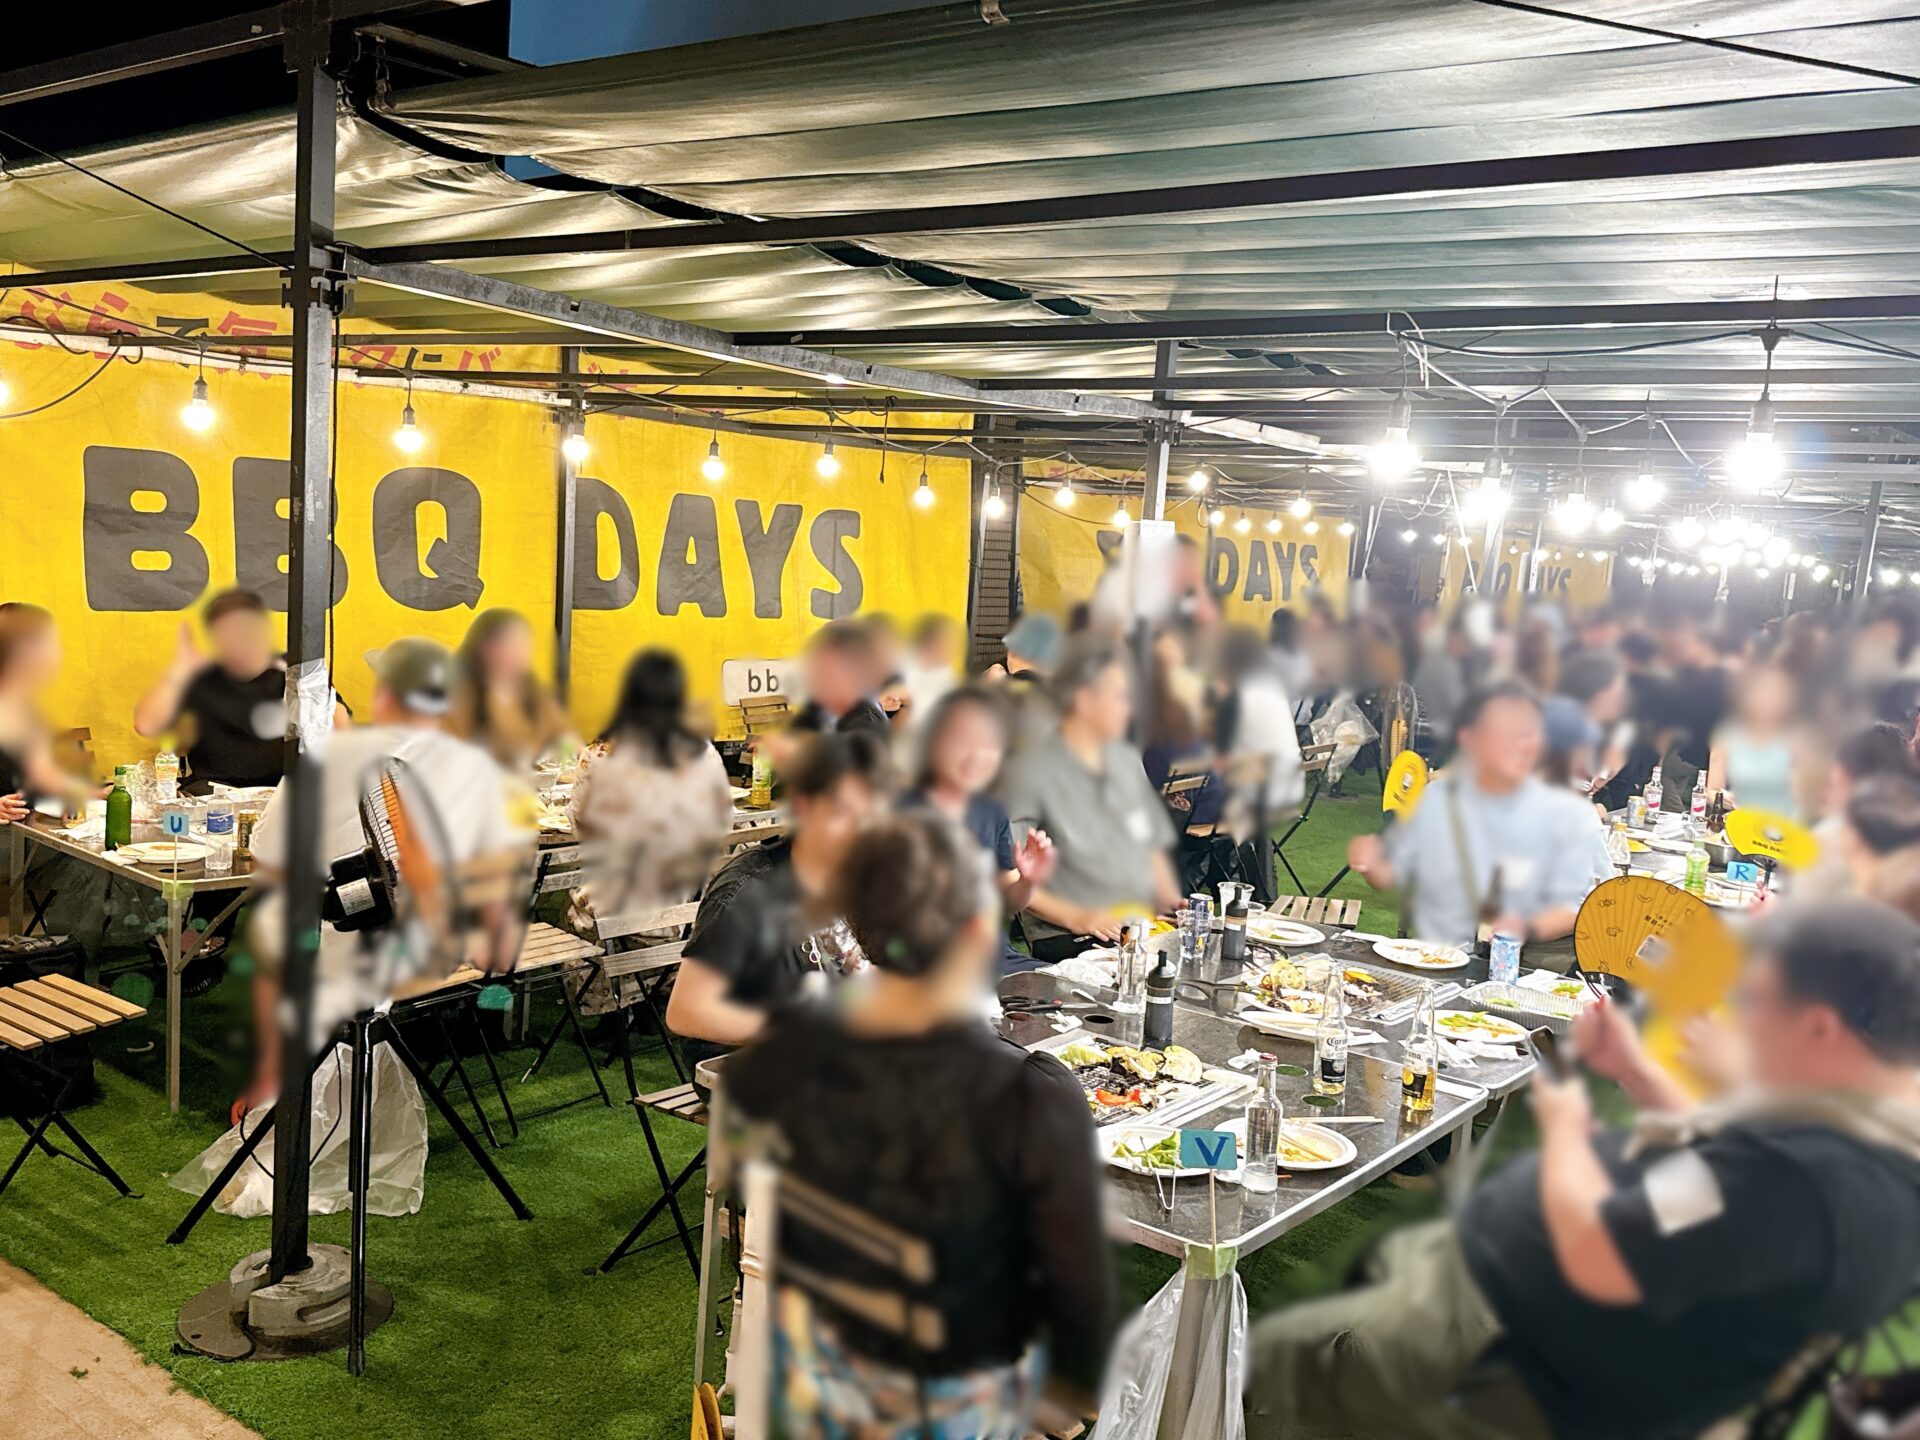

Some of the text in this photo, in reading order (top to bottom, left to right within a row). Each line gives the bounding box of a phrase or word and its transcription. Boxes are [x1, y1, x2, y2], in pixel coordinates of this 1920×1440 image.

[83, 445, 864, 620] BBQ DAYS
[1208, 536, 1319, 602] DAYS
[170, 815, 183, 834] U
[1735, 864, 1750, 881] R
[1194, 1136, 1230, 1167] V
